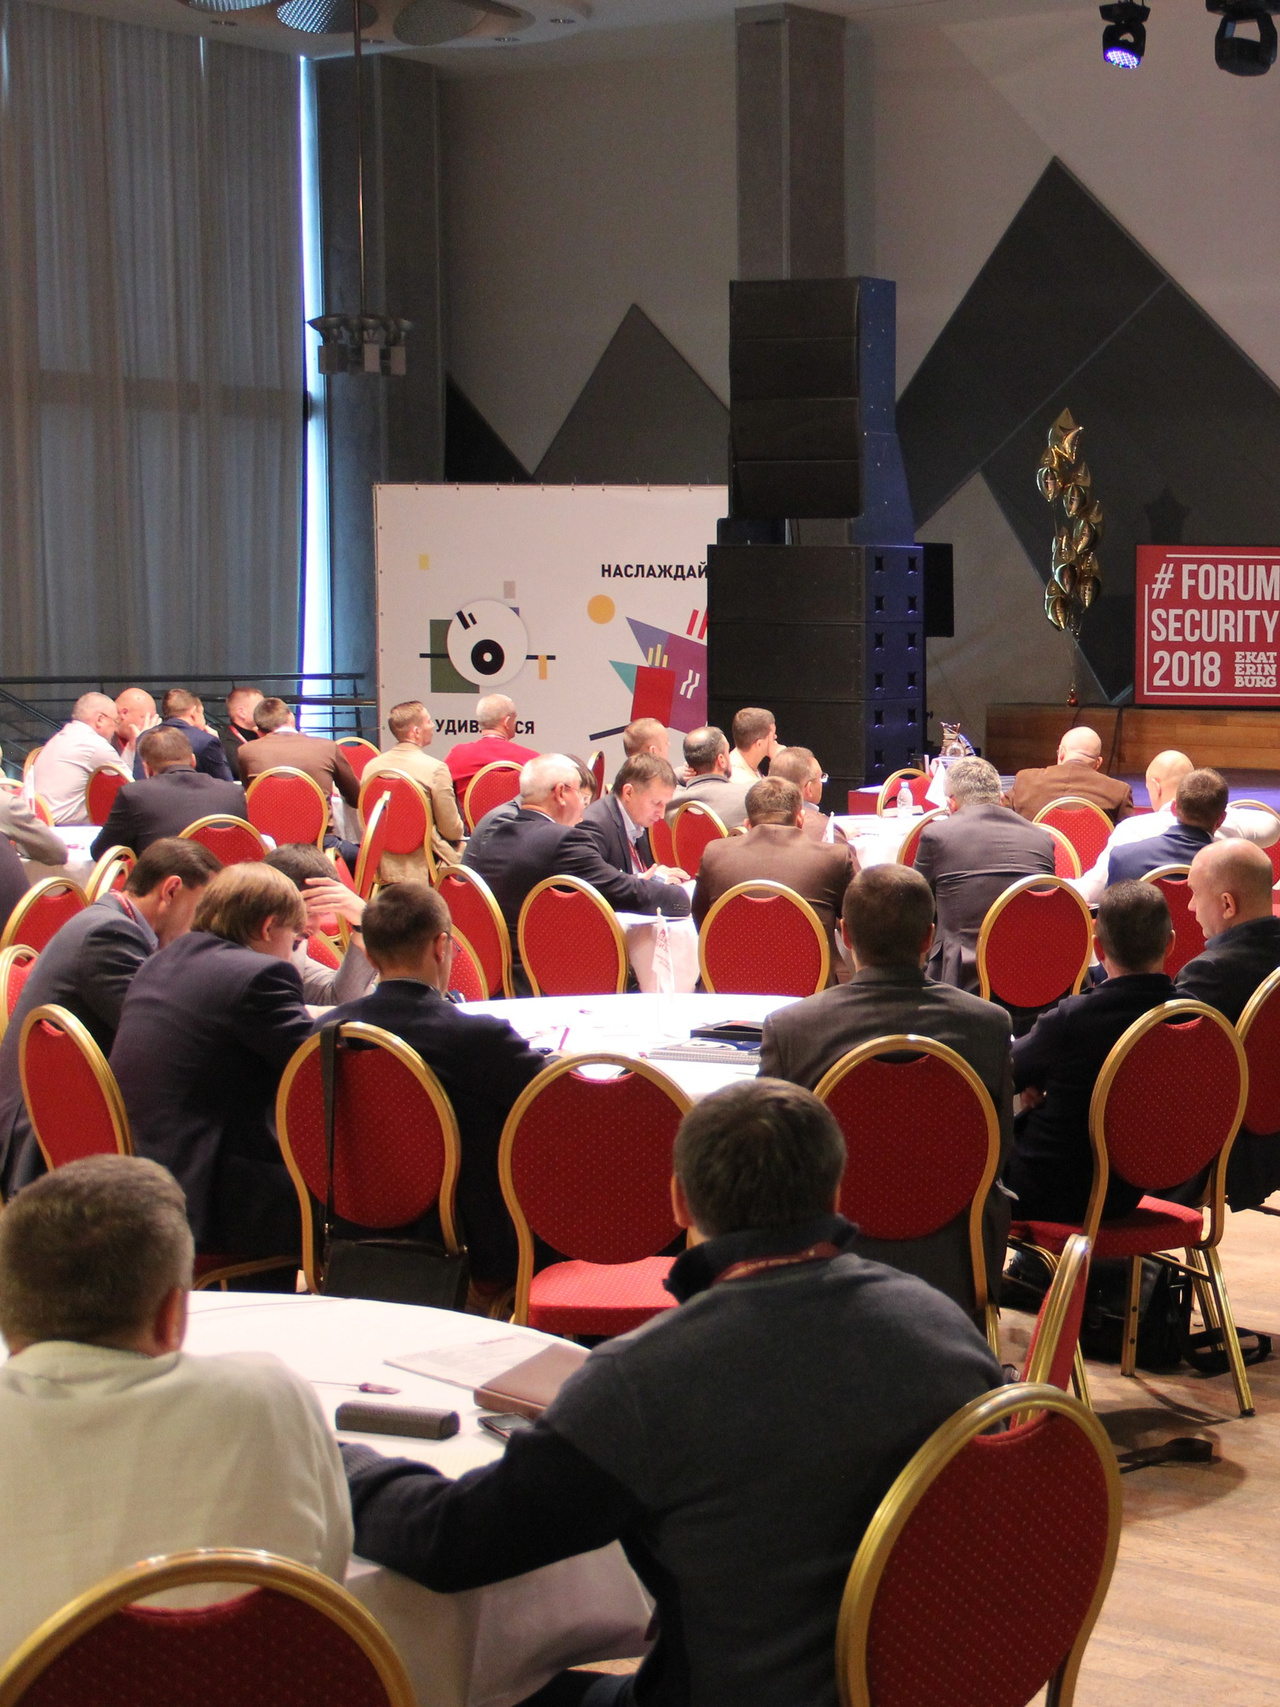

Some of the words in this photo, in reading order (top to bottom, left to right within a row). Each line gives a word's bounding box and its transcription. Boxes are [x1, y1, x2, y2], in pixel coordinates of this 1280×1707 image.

[601, 561, 708, 581] НАСЛАЖДАЙ
[1151, 608, 1280, 643] SECURITY
[1234, 651, 1278, 664] EKAT
[1153, 650, 1221, 687] 2018
[1234, 664, 1277, 676] ERIN
[1234, 676, 1277, 688] BURG
[435, 719, 535, 735] УДИВСЯ
